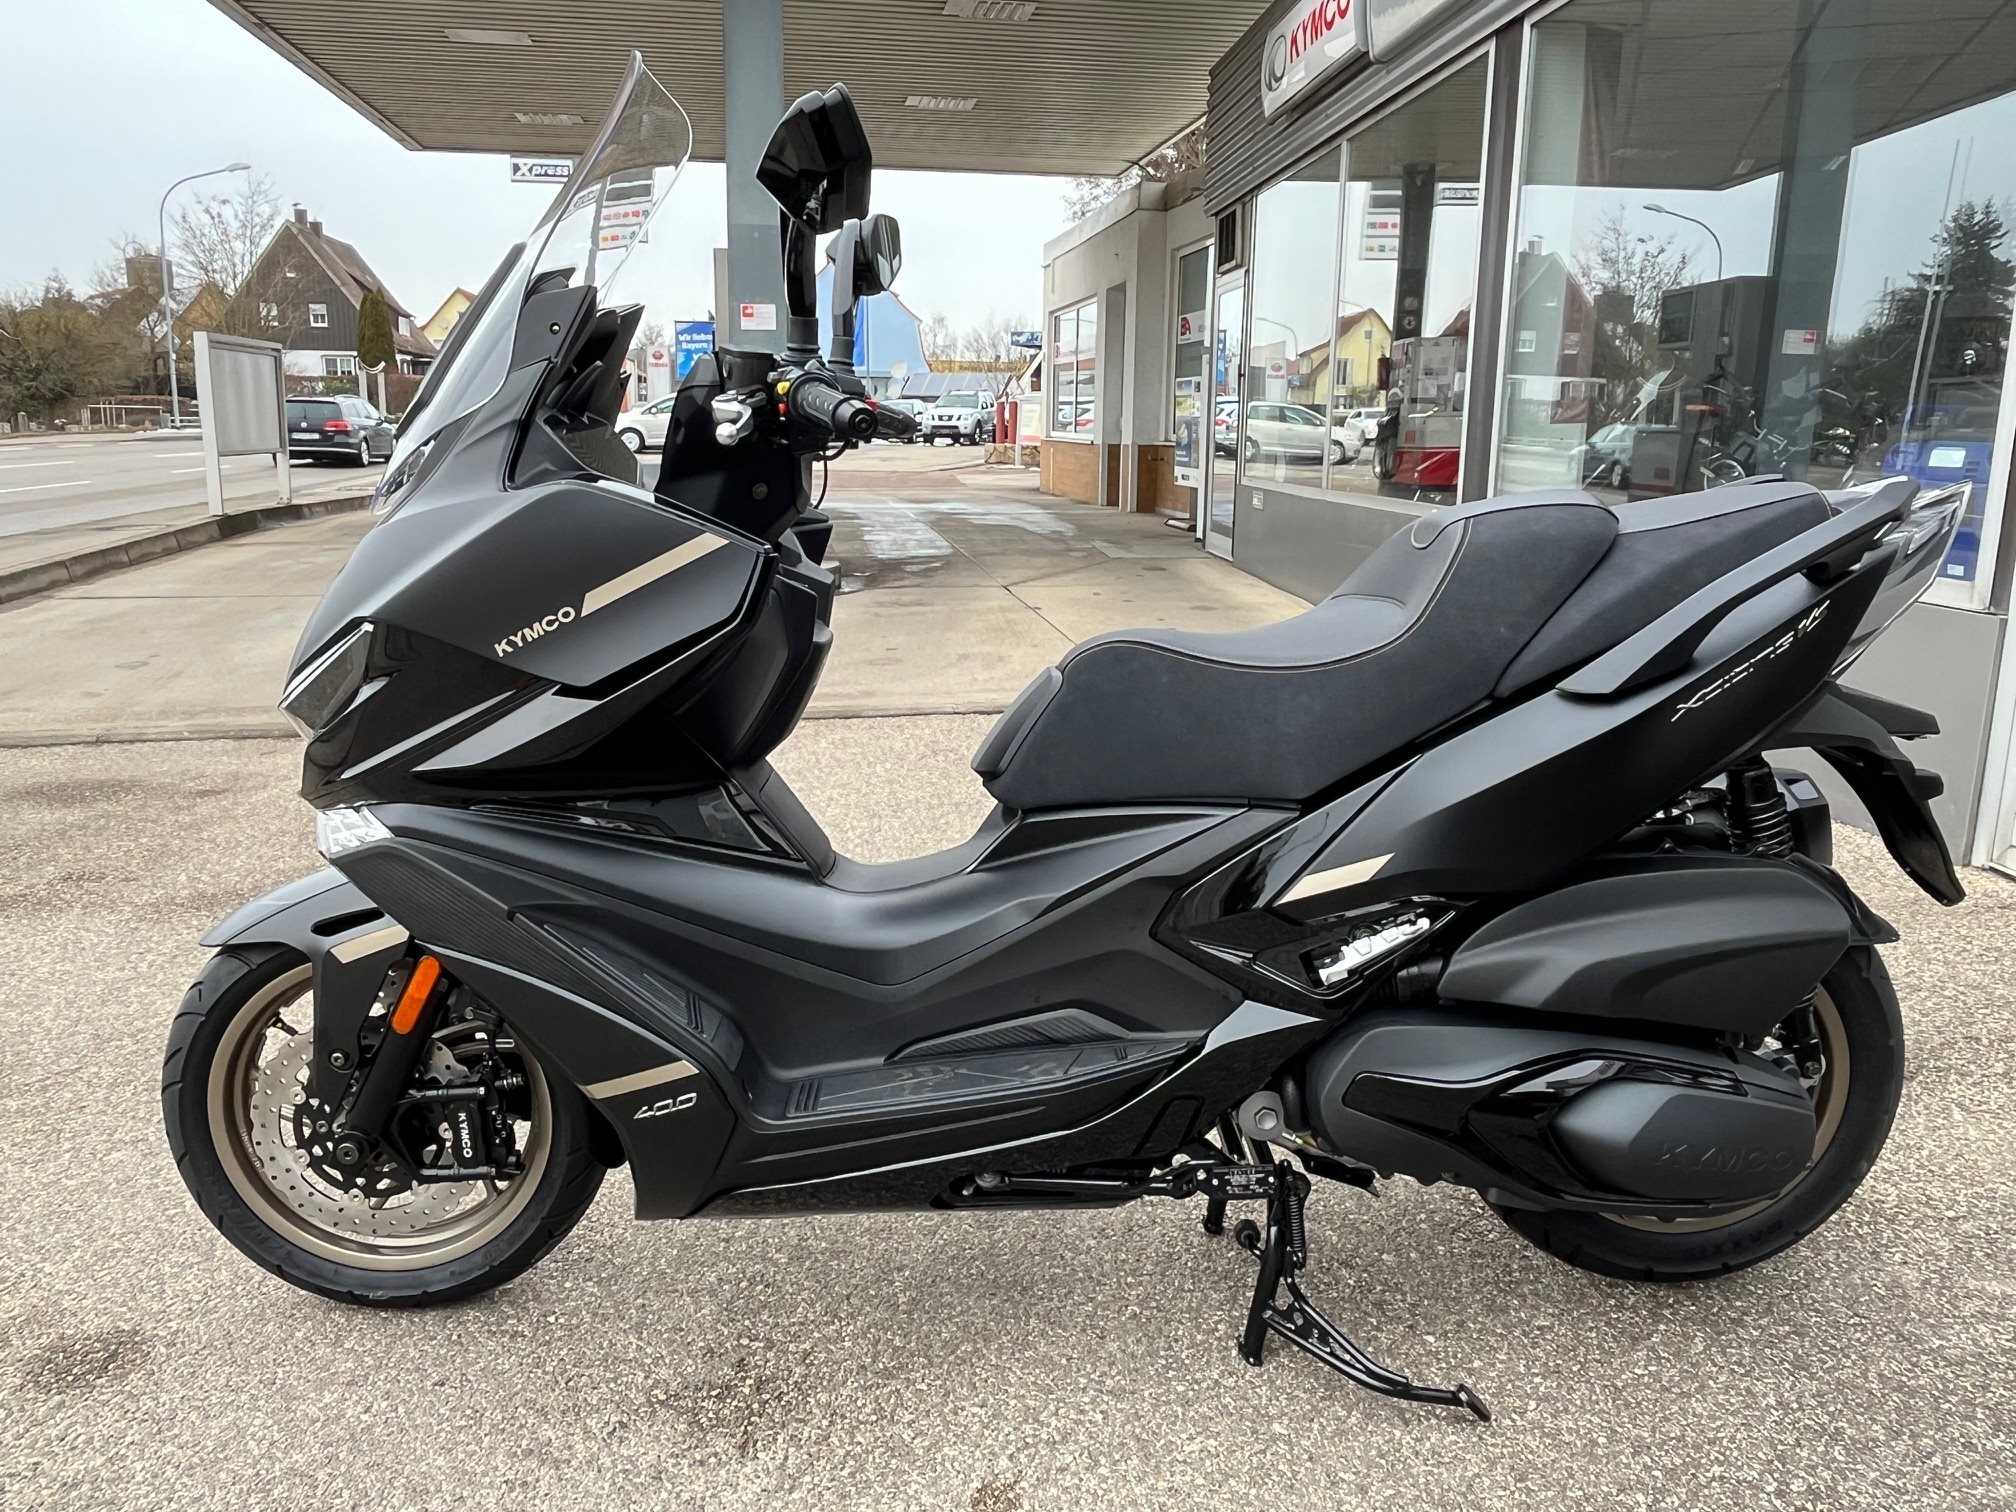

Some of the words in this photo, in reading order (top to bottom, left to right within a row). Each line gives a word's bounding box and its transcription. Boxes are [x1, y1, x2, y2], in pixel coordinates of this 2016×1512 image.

[515, 162, 570, 177] Xpress
[494, 606, 576, 658] KYMCO
[633, 1092, 697, 1120] 400
[457, 1112, 473, 1158] KYMCO
[1653, 1143, 1795, 1173] KYMCO
